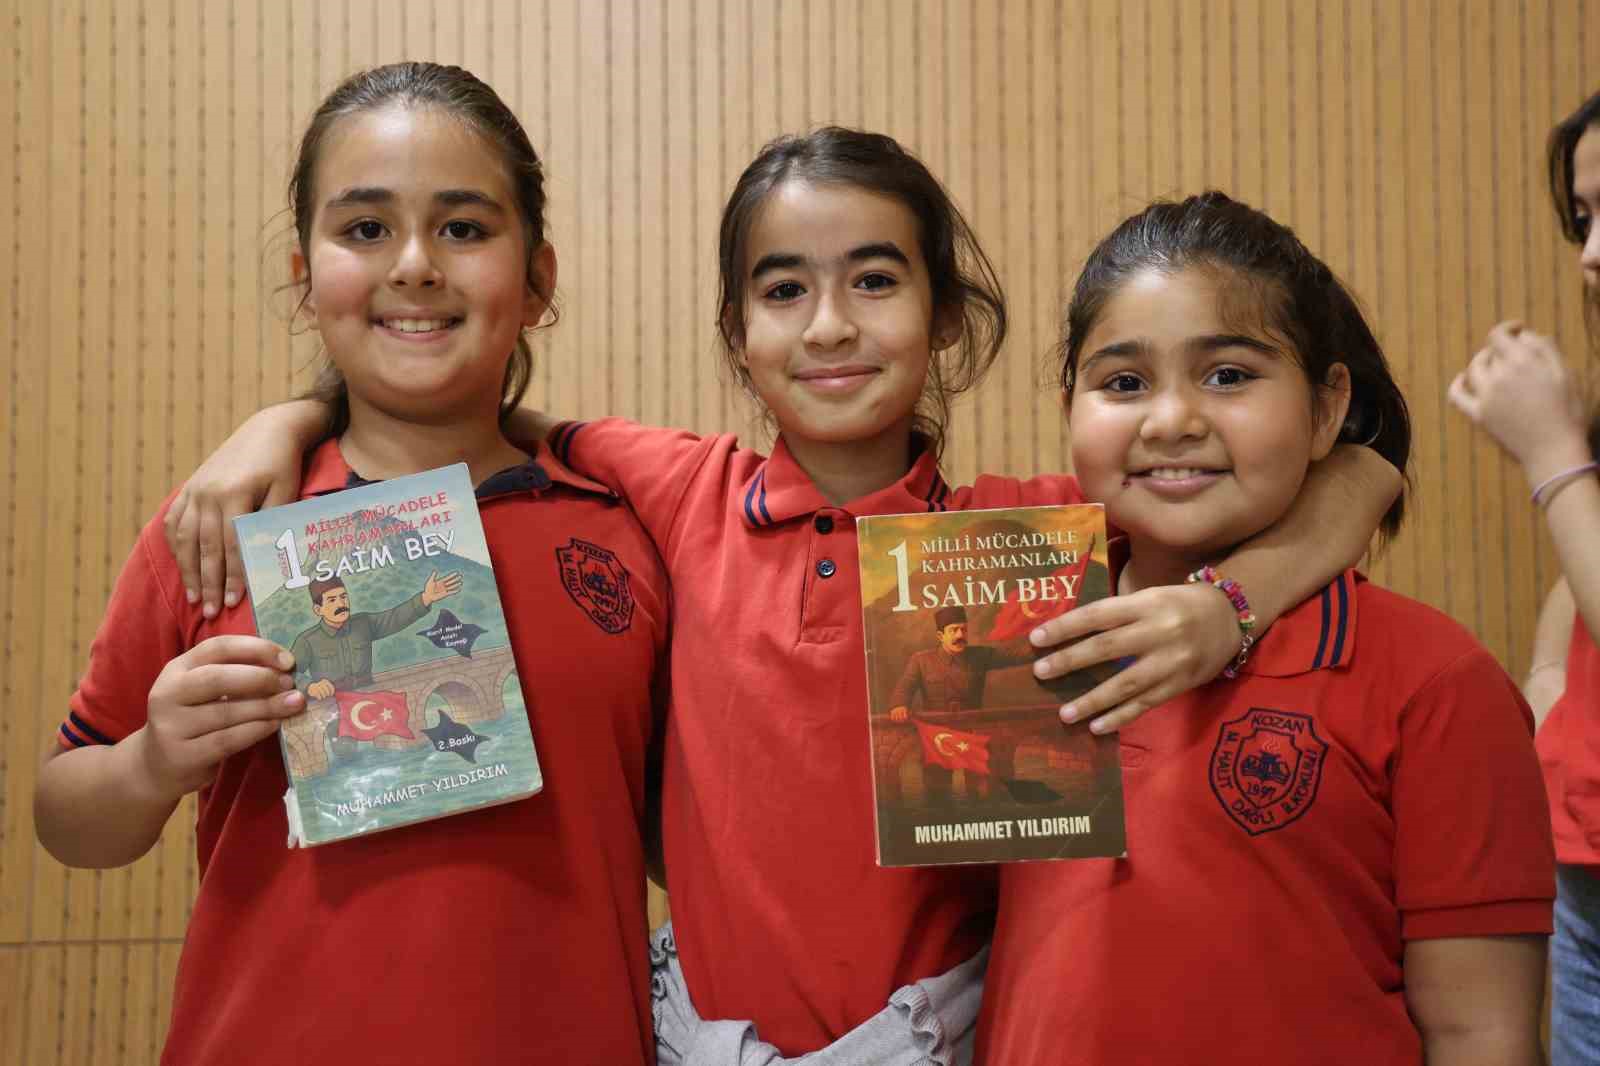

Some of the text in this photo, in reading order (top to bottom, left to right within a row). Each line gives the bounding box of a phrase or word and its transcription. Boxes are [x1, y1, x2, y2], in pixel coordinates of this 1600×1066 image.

[276, 528, 310, 589] 1
[316, 545, 395, 581] SAİM
[404, 530, 454, 560] BEY
[921, 530, 1078, 553] MİLLİ MÜCADELE
[888, 539, 918, 612] 1
[921, 550, 1079, 573] KAHRAMANLARI
[922, 574, 1080, 609] SAİM BEY
[1251, 714, 1304, 734] KOZAN
[336, 764, 508, 816] MUHAMMET YILDIRIM
[915, 815, 1091, 844] MUHAMMET YILDIRIM
